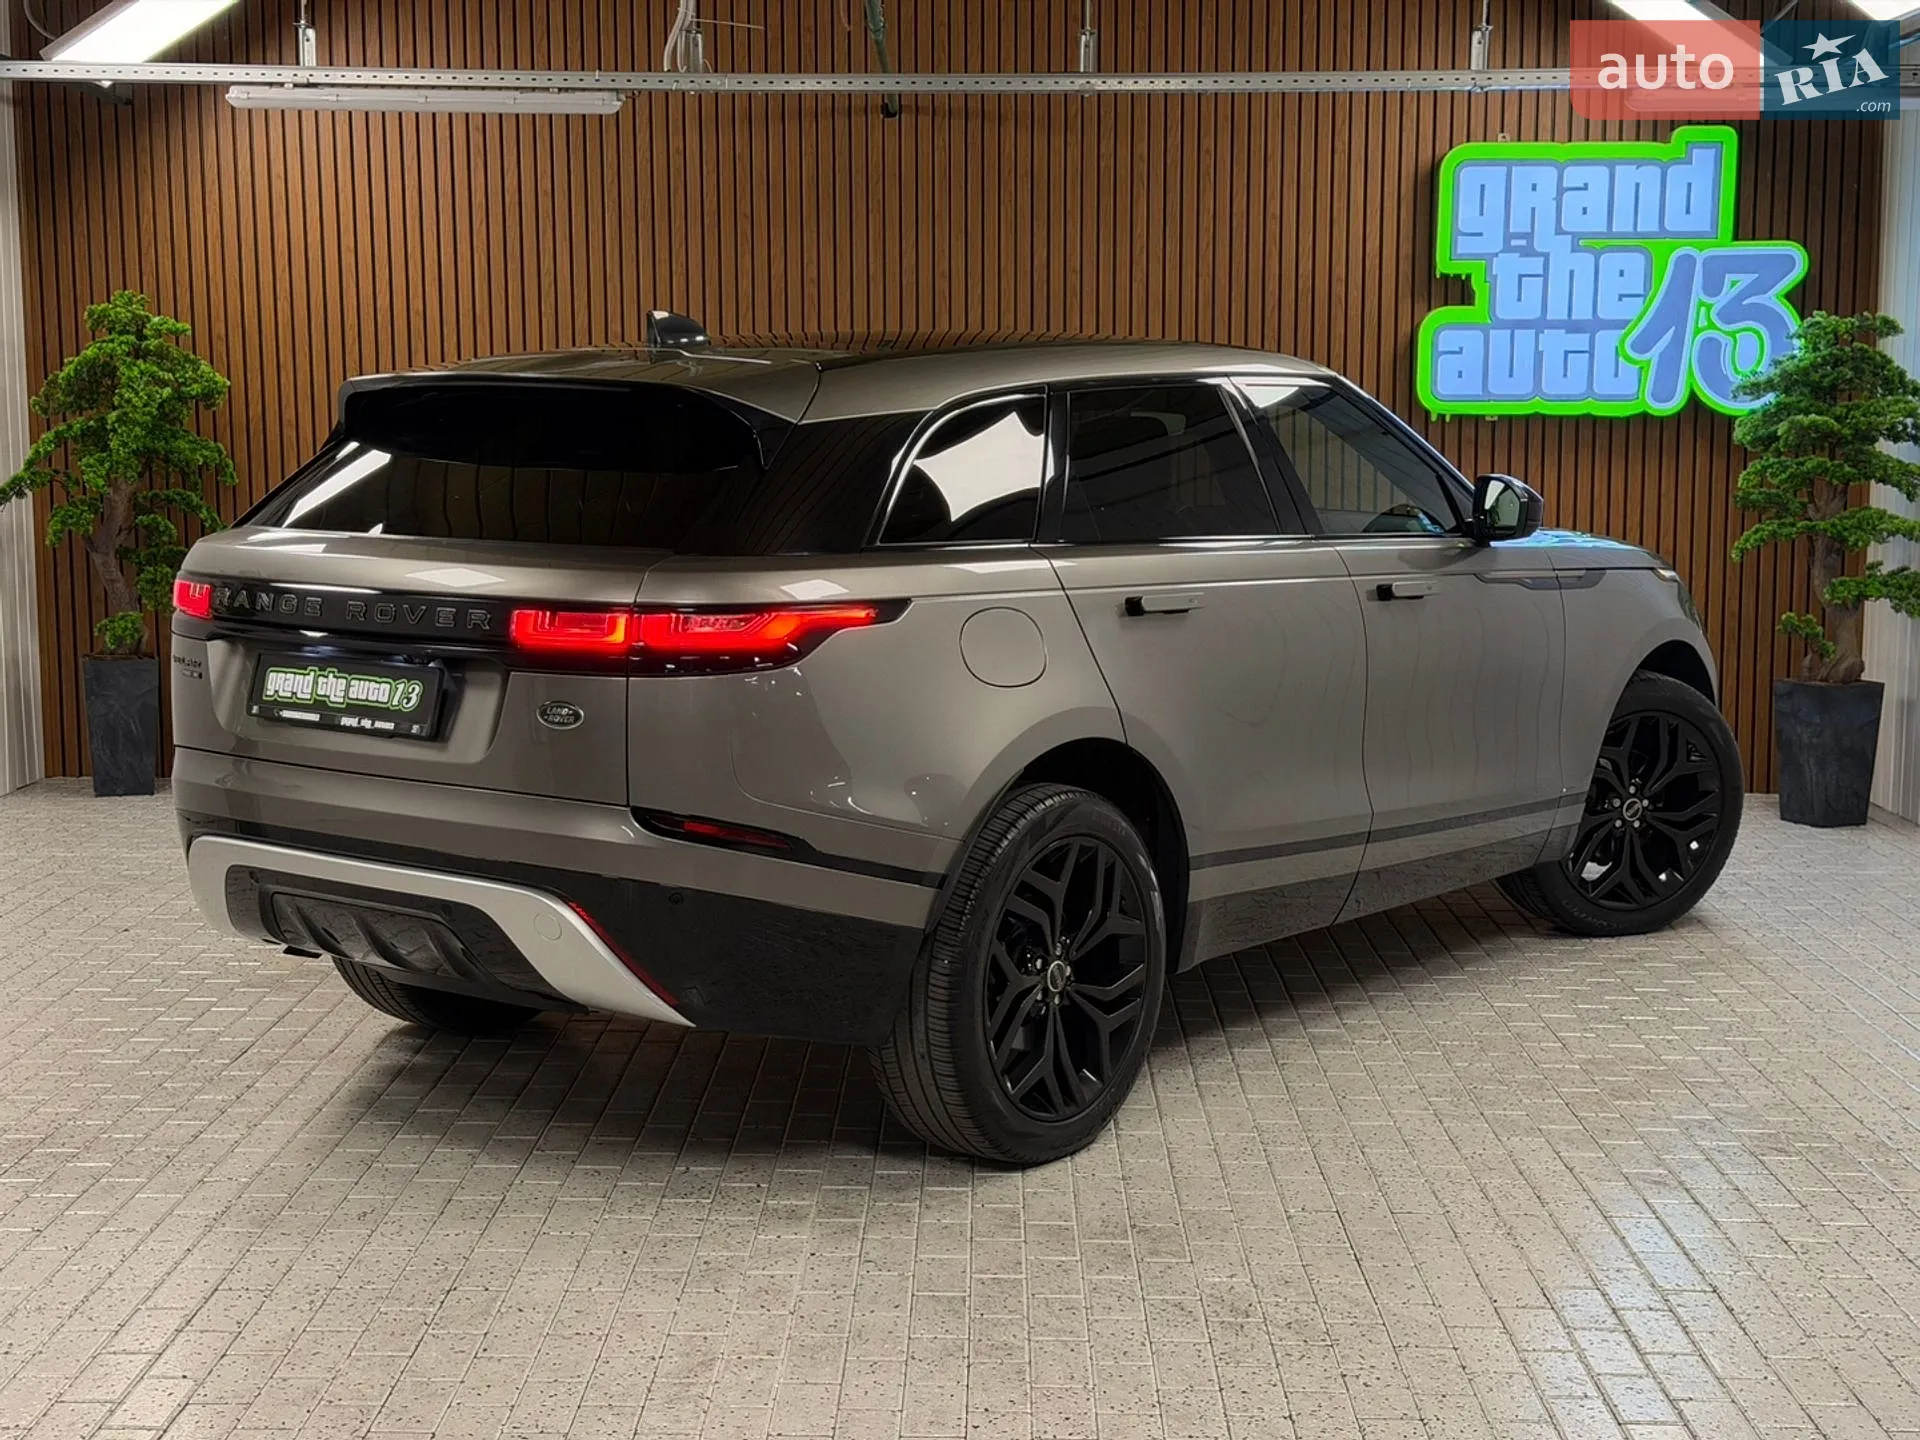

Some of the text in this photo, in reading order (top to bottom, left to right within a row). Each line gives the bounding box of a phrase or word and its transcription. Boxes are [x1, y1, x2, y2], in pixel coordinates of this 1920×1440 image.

[1493, 235, 1651, 321] the
[1627, 247, 1801, 409] 13
[214, 586, 491, 630] RANGE ROVER
[317, 673, 347, 703] the
[349, 678, 391, 703] auto
[392, 682, 421, 708] 13
